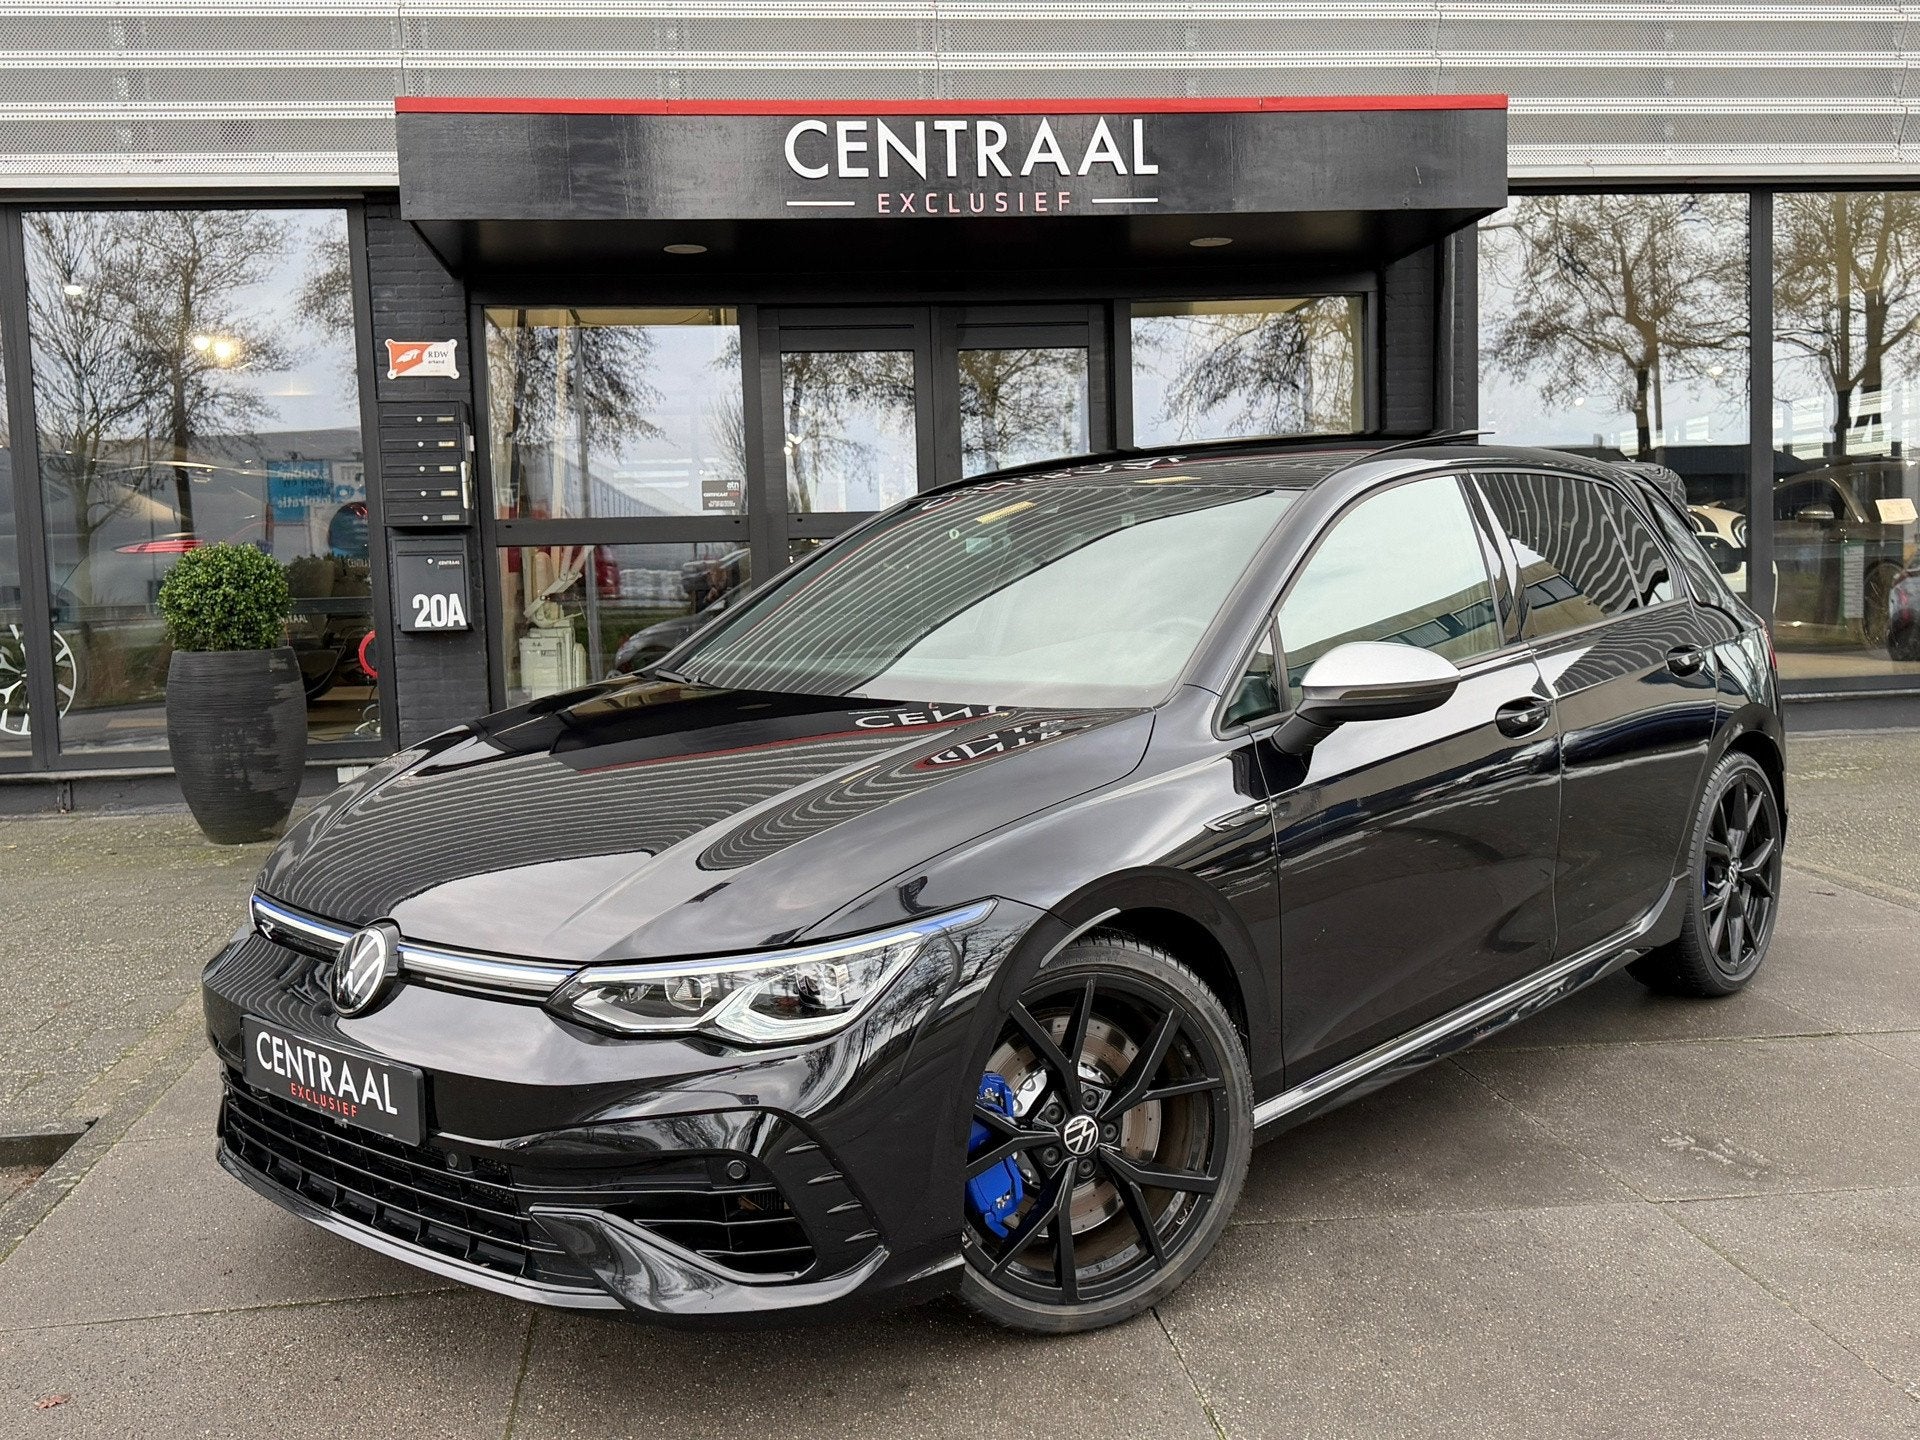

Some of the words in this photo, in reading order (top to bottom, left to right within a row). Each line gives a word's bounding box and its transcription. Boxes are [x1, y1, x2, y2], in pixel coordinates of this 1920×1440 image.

[784, 116, 1159, 181] CENTRAAL
[878, 191, 1071, 214] EXCLUSIEF
[412, 593, 467, 628] 20A
[256, 1031, 398, 1115] CENTRAAL
[290, 1082, 358, 1118] EXCLUSIEF
